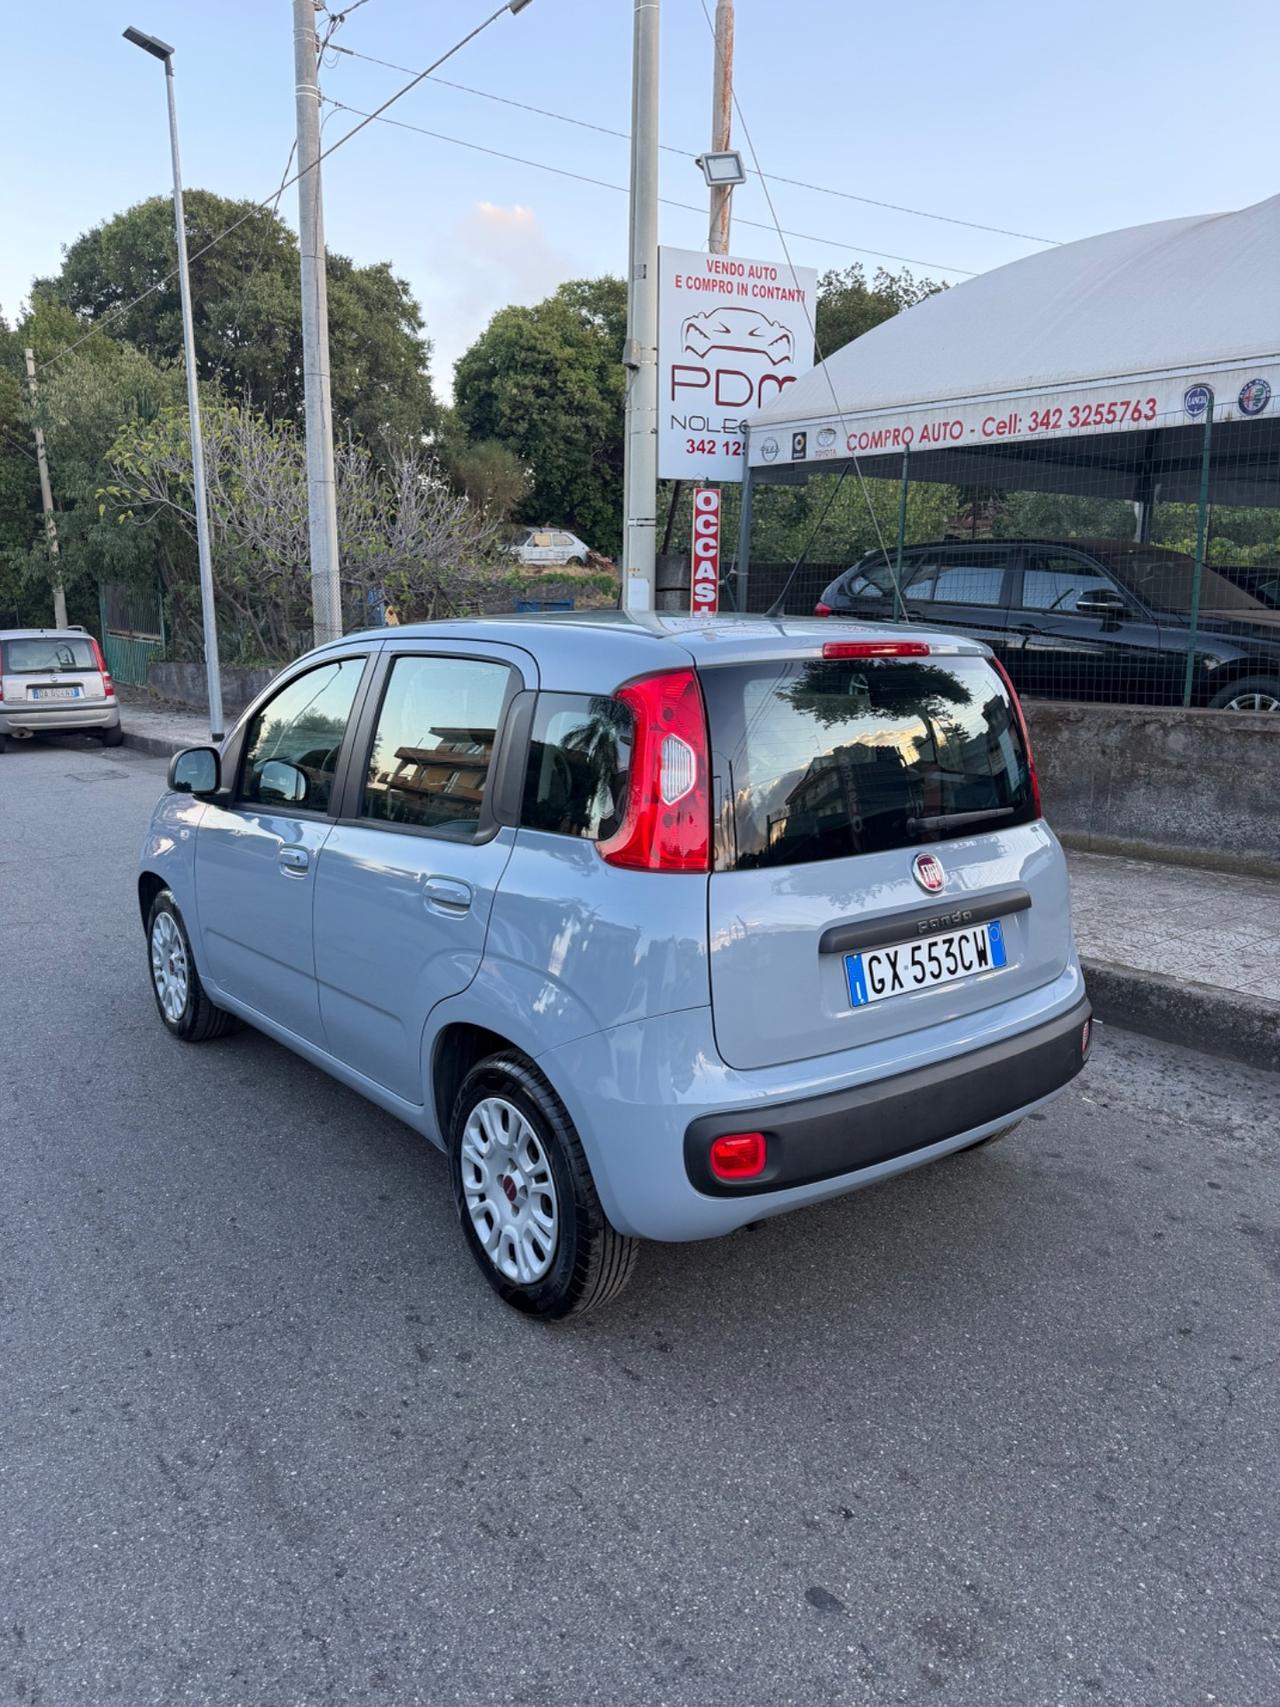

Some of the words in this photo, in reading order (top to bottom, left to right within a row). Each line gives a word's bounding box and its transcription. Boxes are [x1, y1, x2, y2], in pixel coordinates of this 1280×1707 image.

[706, 259, 745, 276] VENDO
[748, 265, 777, 281] AUTO
[675, 274, 682, 288] E
[686, 276, 733, 294] COMPRO
[737, 282, 749, 296] IN
[752, 284, 806, 303] CONTANTI
[846, 426, 914, 451] COMPRO
[918, 420, 963, 443] AUTO
[981, 413, 1022, 437] Cell:
[1028, 408, 1063, 432] 342
[1068, 398, 1157, 429] 3255763
[686, 439, 716, 454] 342
[868, 950, 904, 995] GX
[911, 928, 989, 984] 553CW
